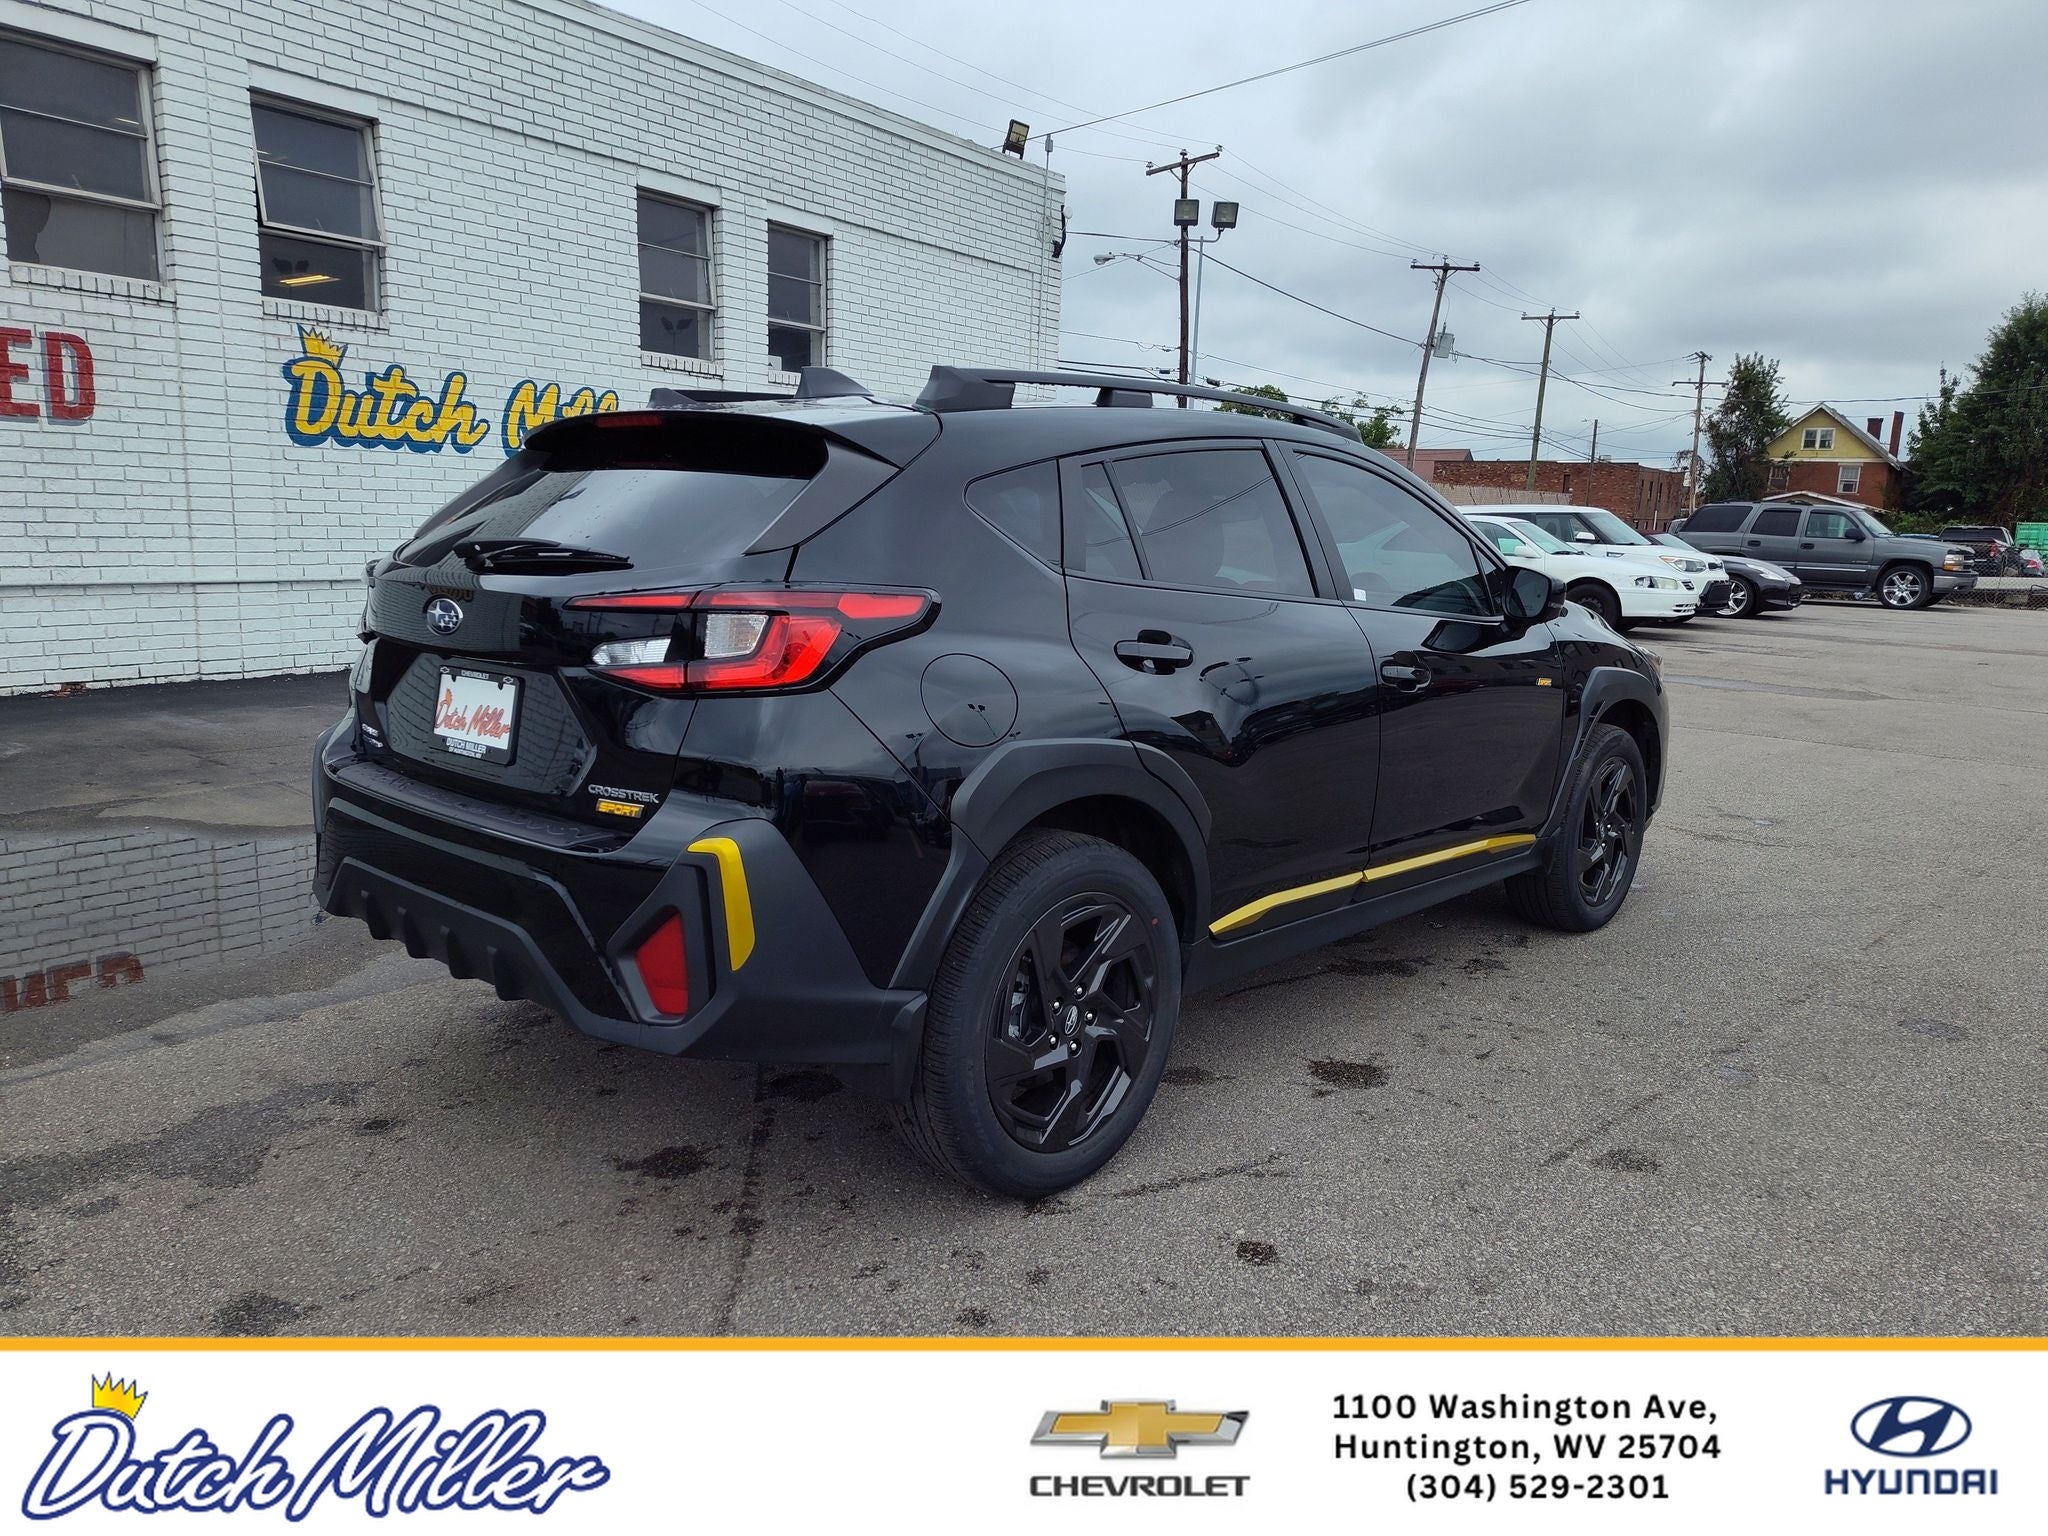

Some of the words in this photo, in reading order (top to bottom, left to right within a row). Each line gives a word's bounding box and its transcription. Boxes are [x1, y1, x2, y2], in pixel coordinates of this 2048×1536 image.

[282, 356, 490, 454] Dutch
[466, 704, 511, 739] Miller
[446, 738, 466, 750] DUTCH
[465, 741, 487, 754] MILLER
[588, 783, 660, 804] CROSSTREK
[597, 801, 640, 817] SPORT
